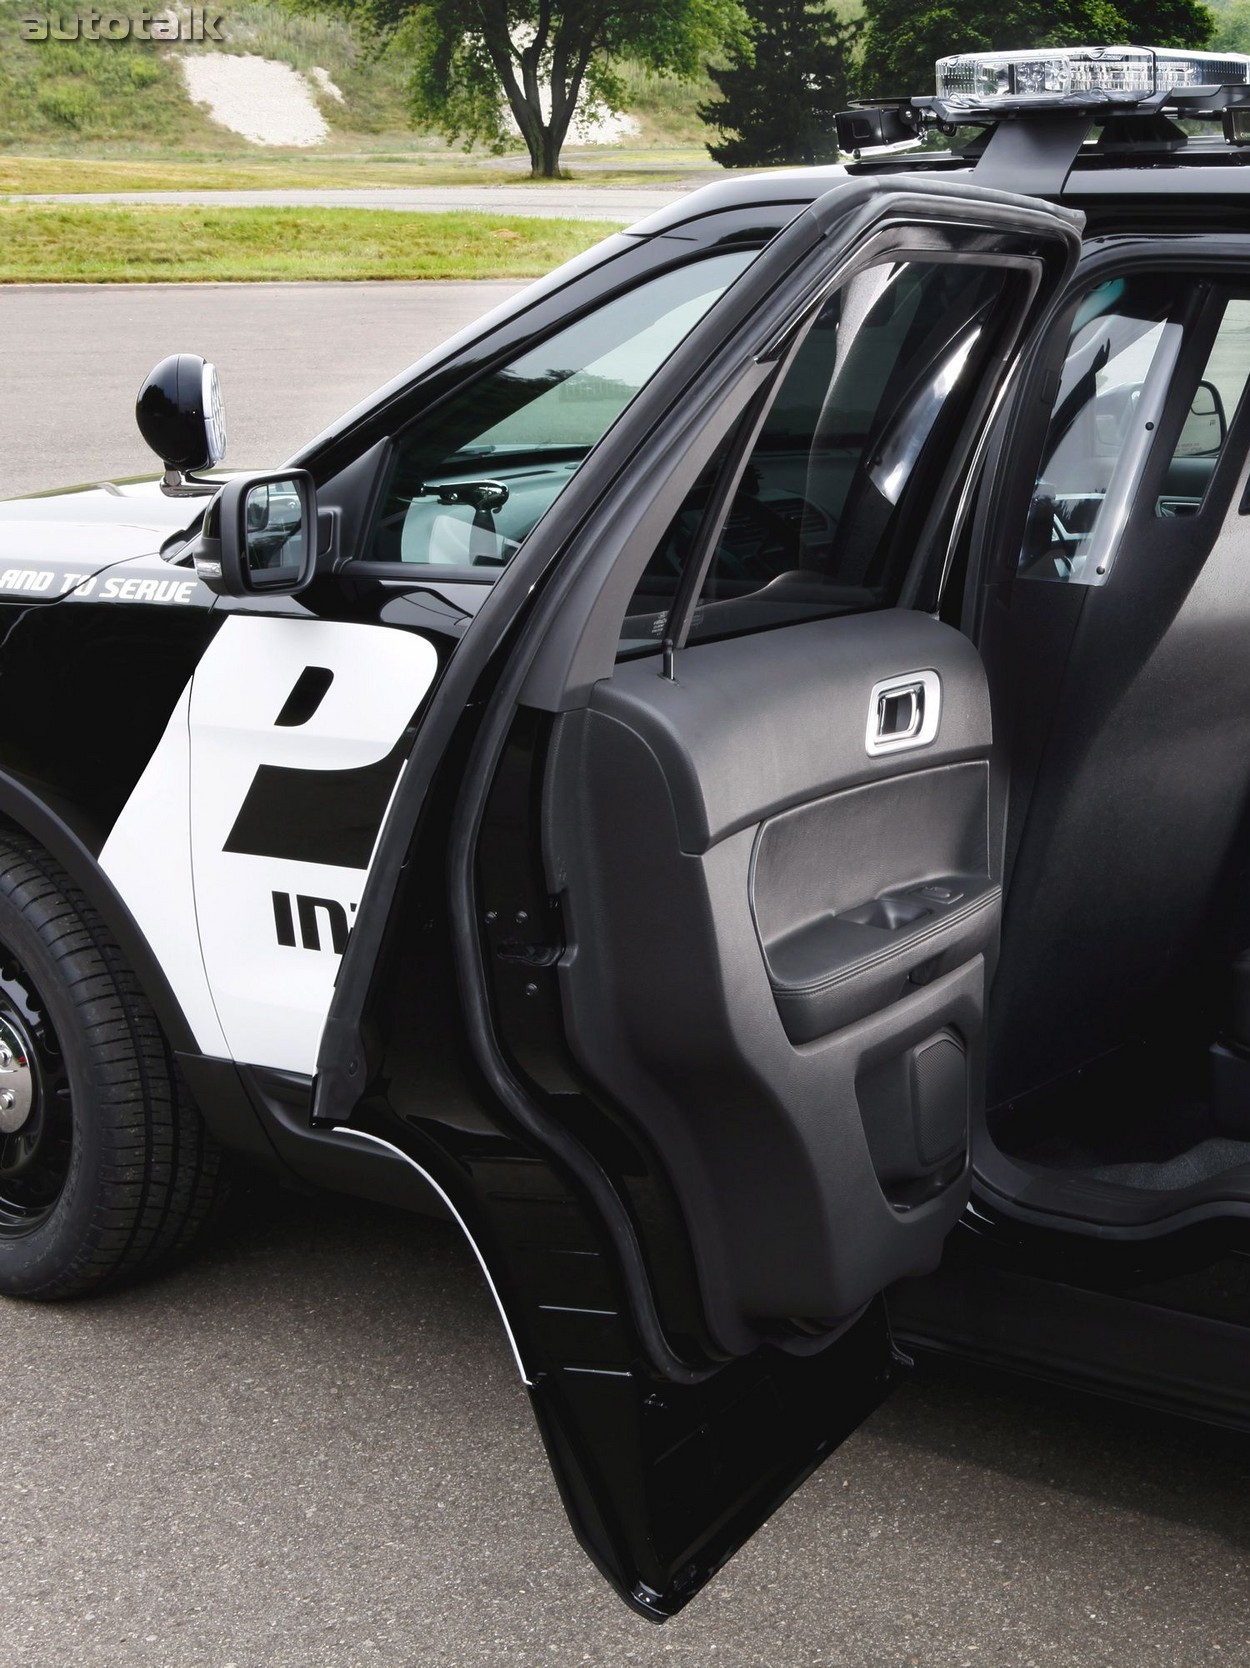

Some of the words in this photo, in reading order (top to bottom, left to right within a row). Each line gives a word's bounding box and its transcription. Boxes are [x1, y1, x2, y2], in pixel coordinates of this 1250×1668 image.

[0, 569, 55, 592] AND
[59, 573, 98, 597] TO
[98, 577, 198, 603] SERVE
